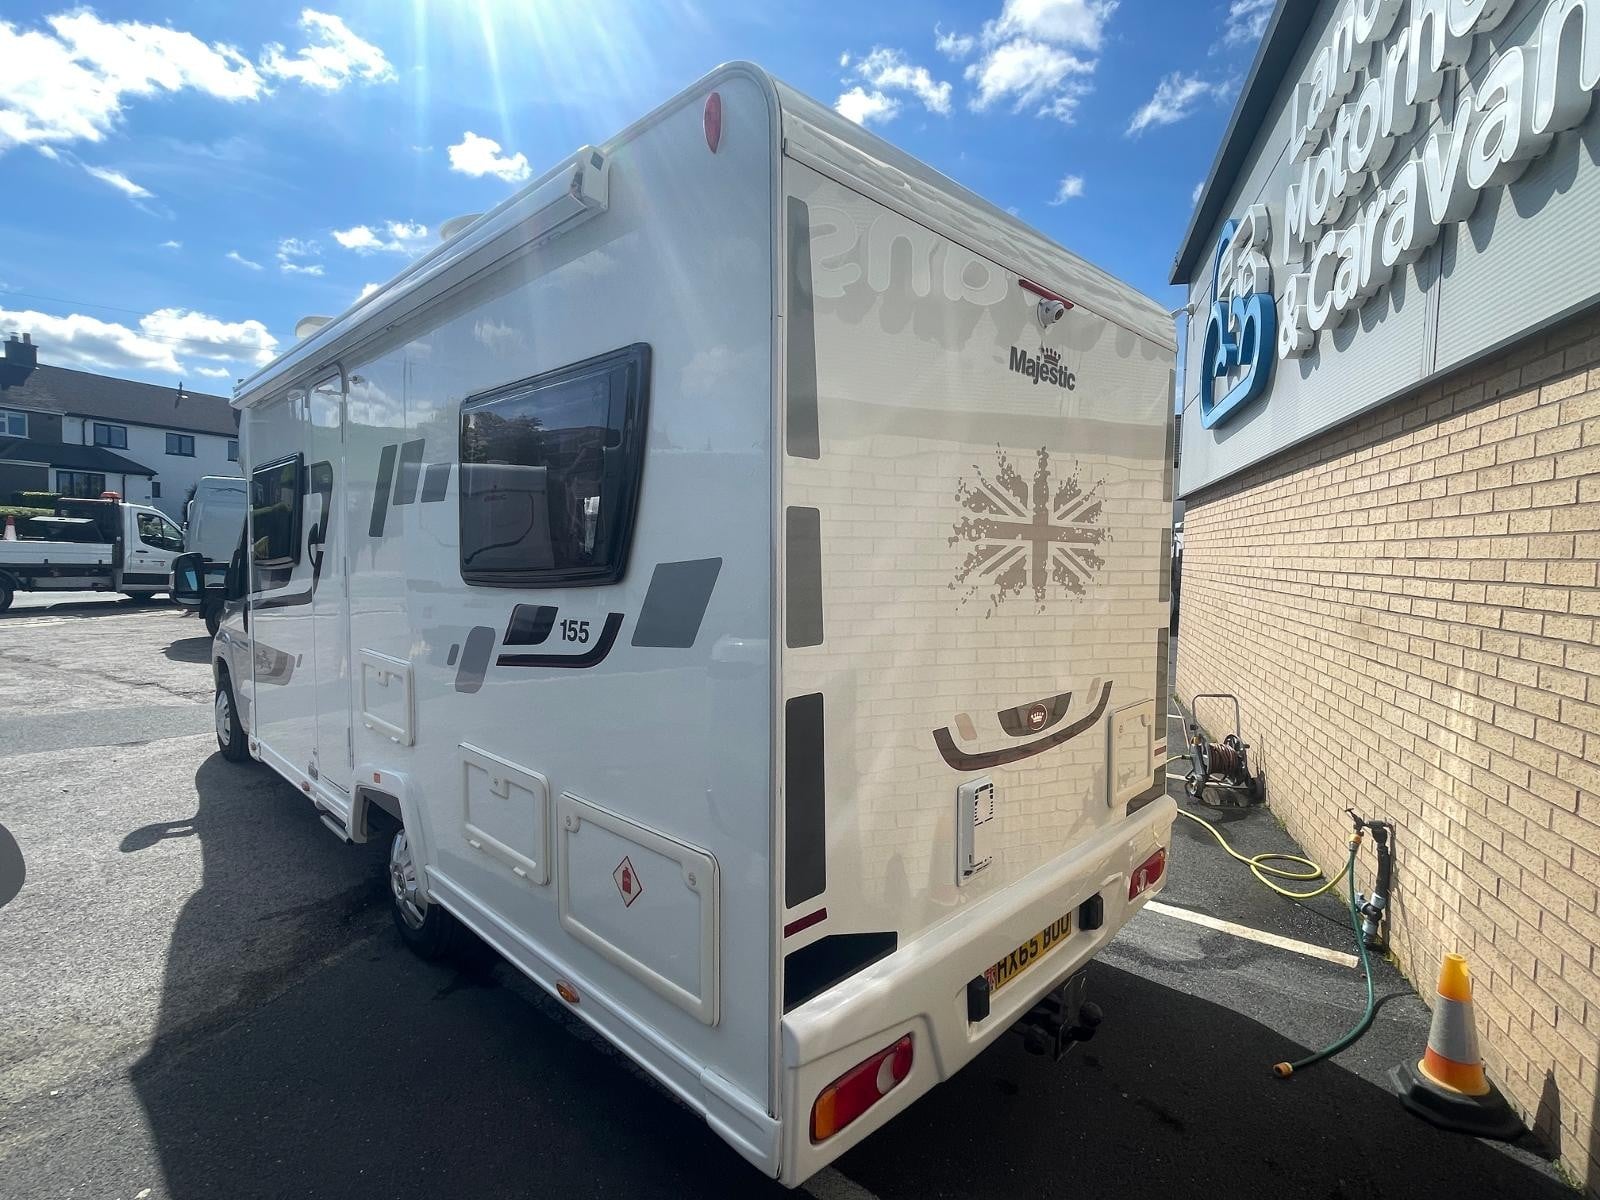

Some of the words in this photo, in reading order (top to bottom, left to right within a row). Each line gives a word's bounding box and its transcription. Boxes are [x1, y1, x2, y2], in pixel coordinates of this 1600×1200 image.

[1278, 274, 1306, 360] &
[1009, 345, 1076, 391] Majestic
[559, 618, 590, 644] 155
